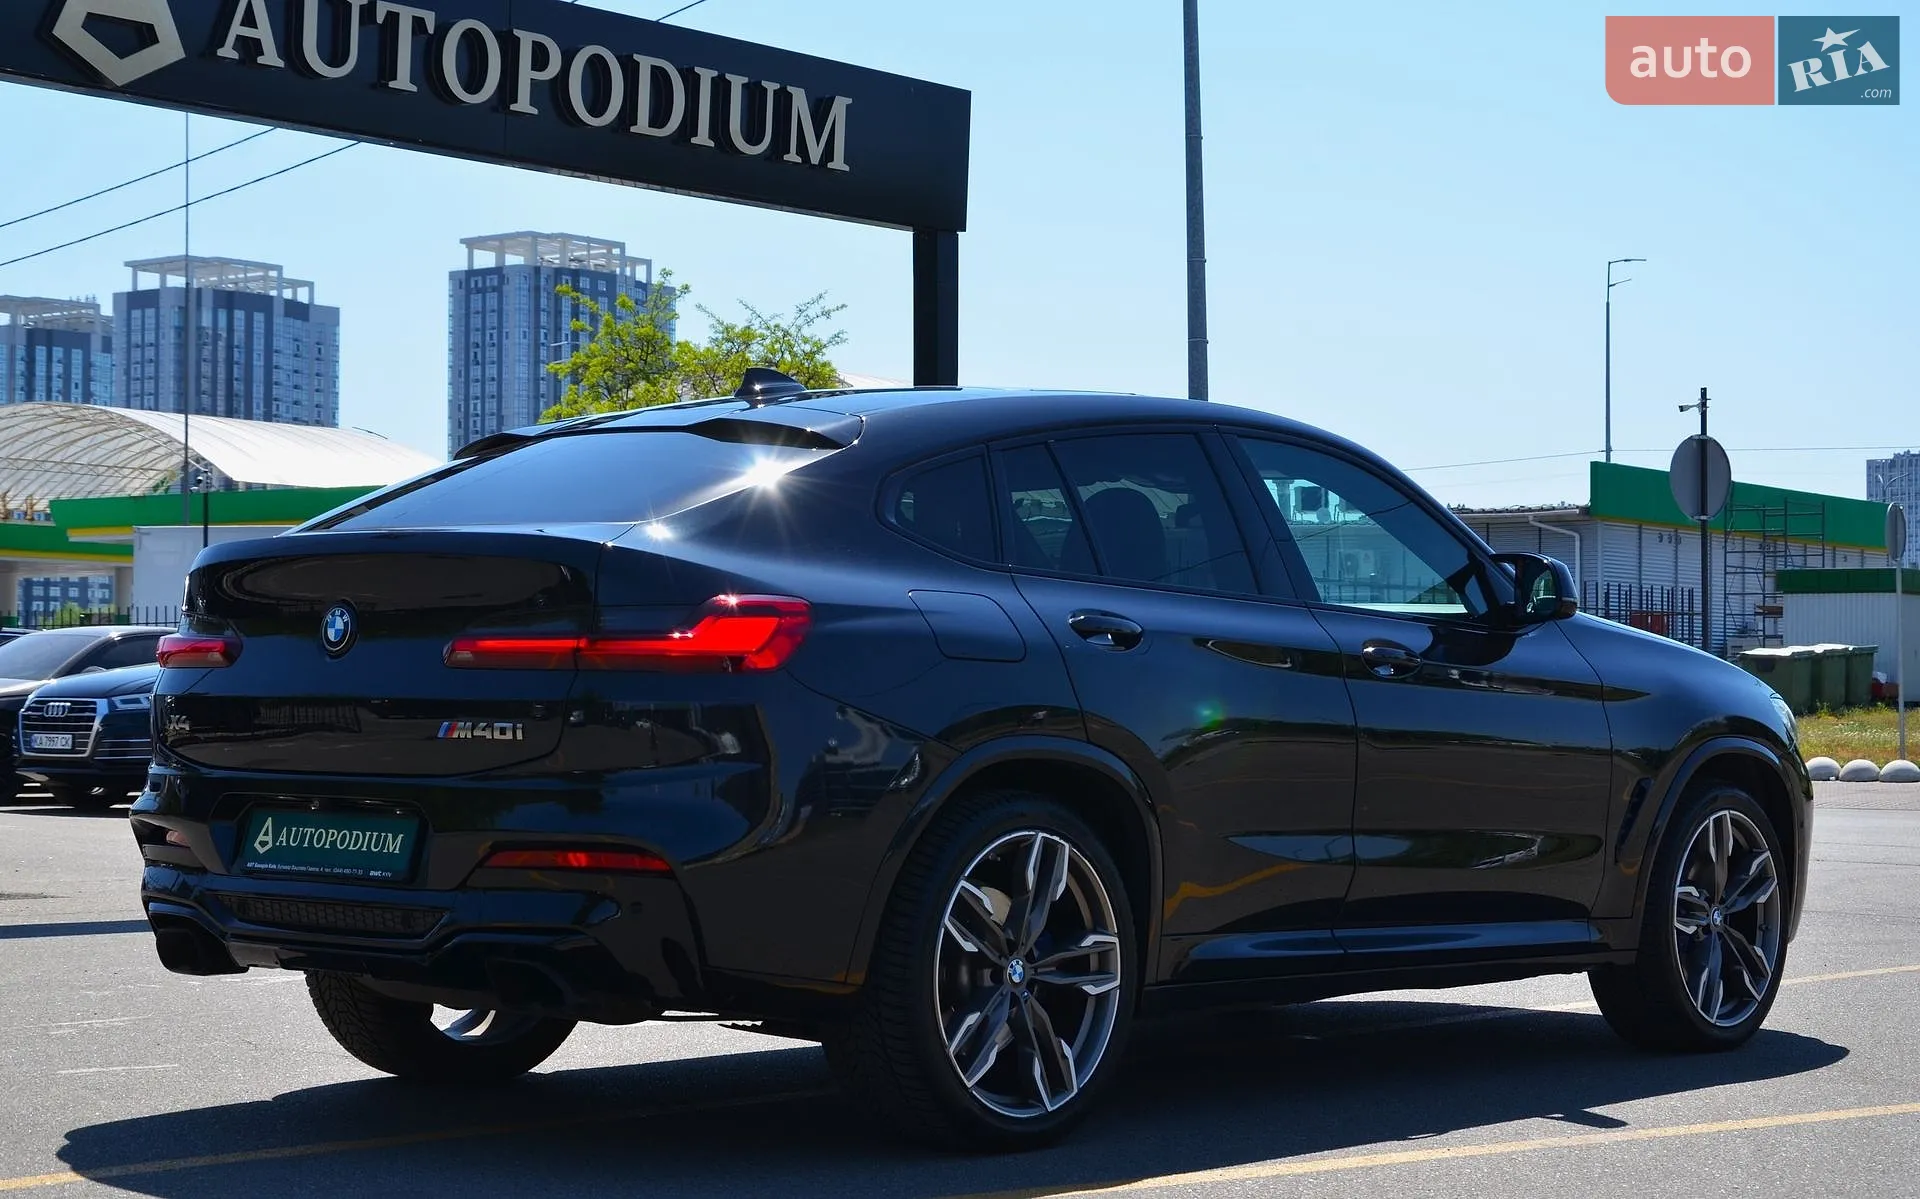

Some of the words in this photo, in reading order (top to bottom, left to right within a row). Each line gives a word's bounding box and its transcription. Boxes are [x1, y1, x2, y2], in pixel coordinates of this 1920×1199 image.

[217, 0, 852, 173] AUTOPODIUM
[169, 714, 190, 731] X4
[437, 721, 524, 740] M40i
[275, 826, 404, 854] AUTOPODIUM
